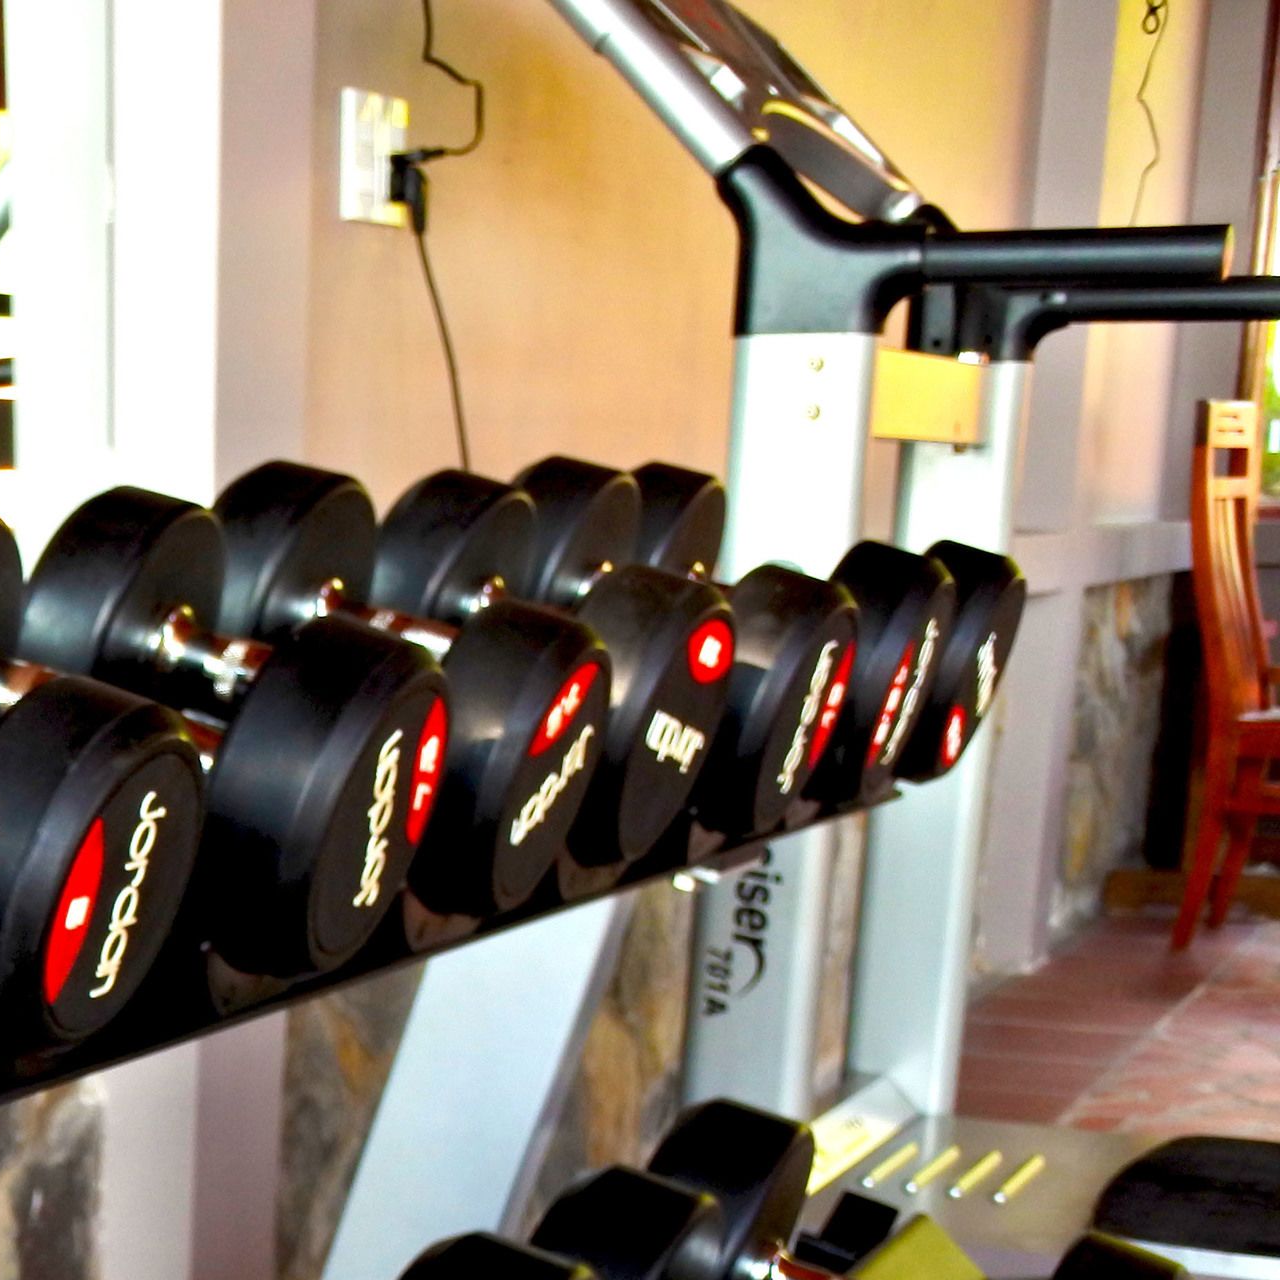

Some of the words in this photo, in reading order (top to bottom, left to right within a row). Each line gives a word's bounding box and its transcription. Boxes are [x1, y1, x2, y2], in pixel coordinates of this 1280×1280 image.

[777, 640, 839, 794] jordan
[89, 790, 167, 998] jordan
[352, 729, 403, 906] jordan
